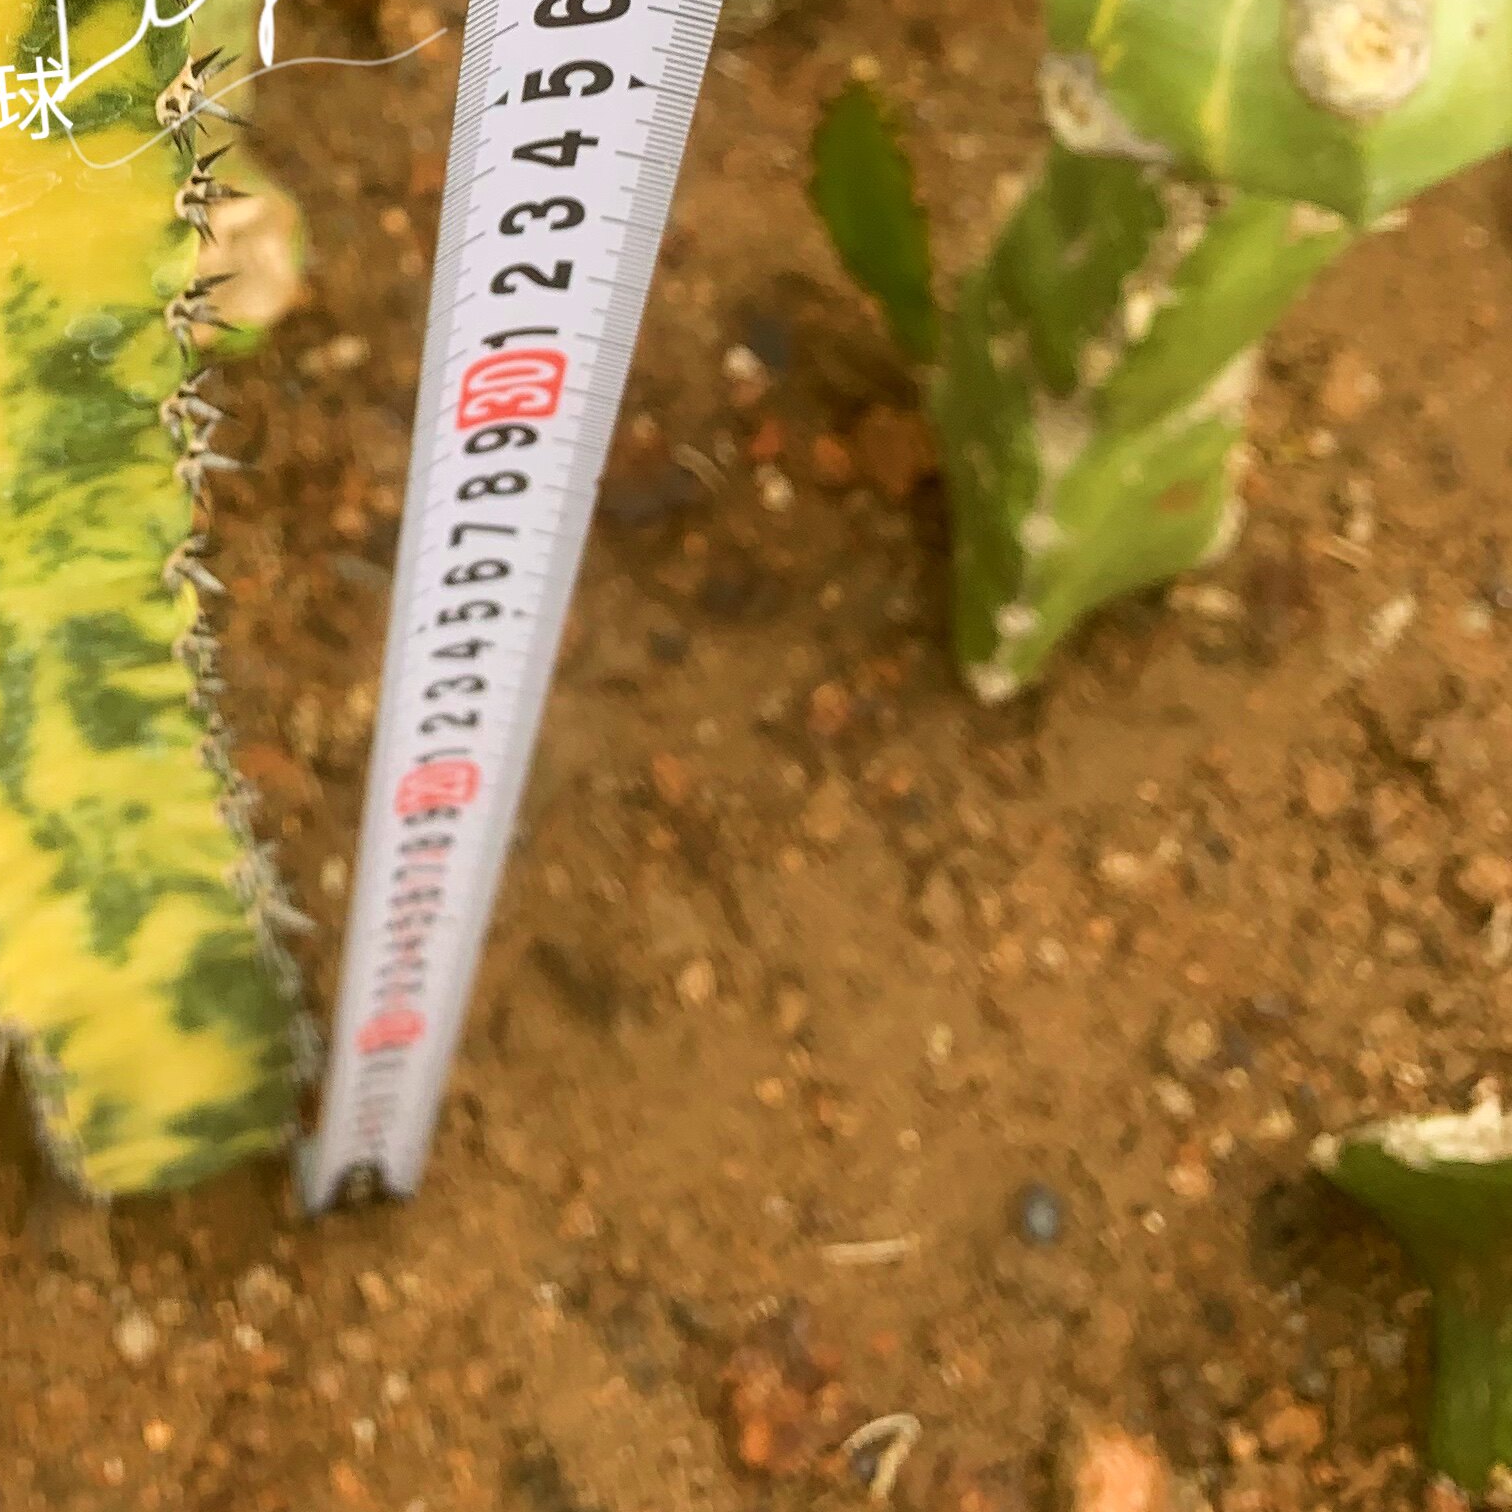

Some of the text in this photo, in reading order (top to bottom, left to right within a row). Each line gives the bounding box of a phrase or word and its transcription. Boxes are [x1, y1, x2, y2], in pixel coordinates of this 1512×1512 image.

[520, 60, 614, 103] 5
[512, 129, 599, 168] 4
[498, 196, 586, 236] 3
[489, 260, 574, 296] 2
[481, 326, 559, 349] 1
[464, 358, 558, 417] 30
[462, 422, 538, 455] 9
[455, 469, 529, 501] 8
[447, 521, 519, 548] 7
[441, 557, 512, 586] 6
[435, 599, 501, 626] 5
